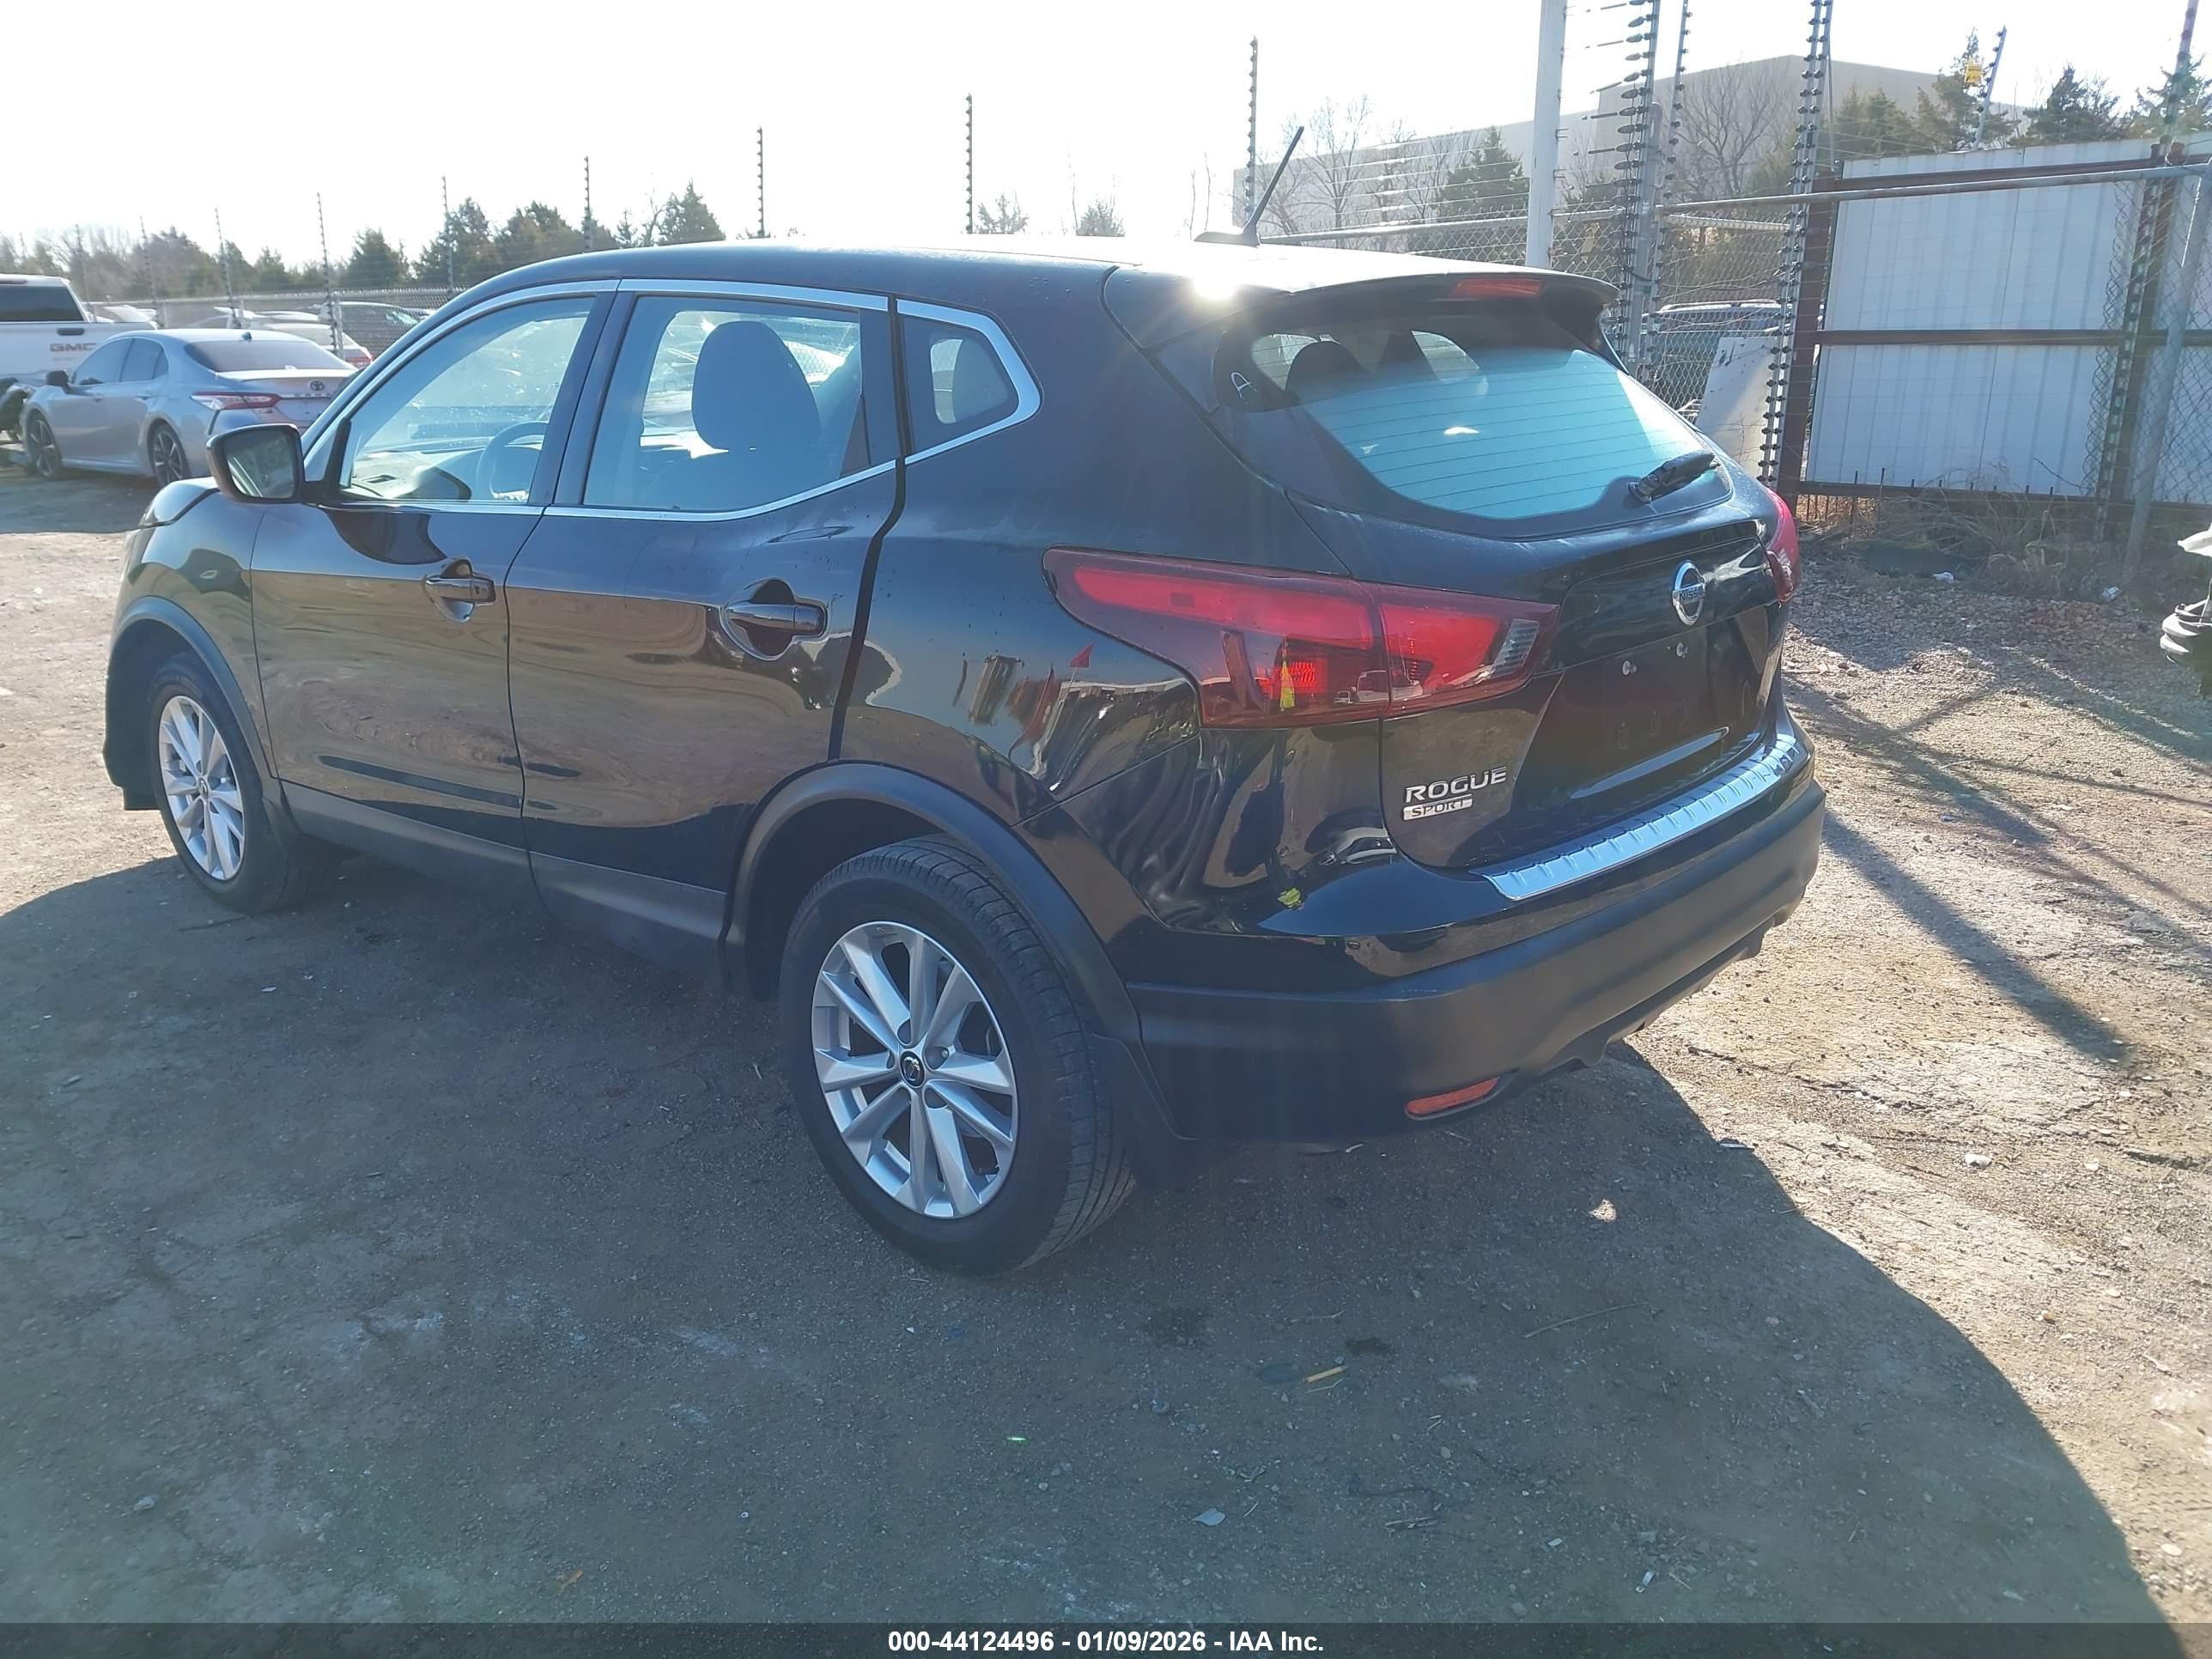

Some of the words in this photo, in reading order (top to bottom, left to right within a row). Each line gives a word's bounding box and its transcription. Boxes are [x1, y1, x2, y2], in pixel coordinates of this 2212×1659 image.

[49, 343, 96, 352] GMC
[1679, 586, 1705, 600] NISS
[1405, 766, 1507, 803] ROGUE
[1410, 798, 1466, 818] SPORT
